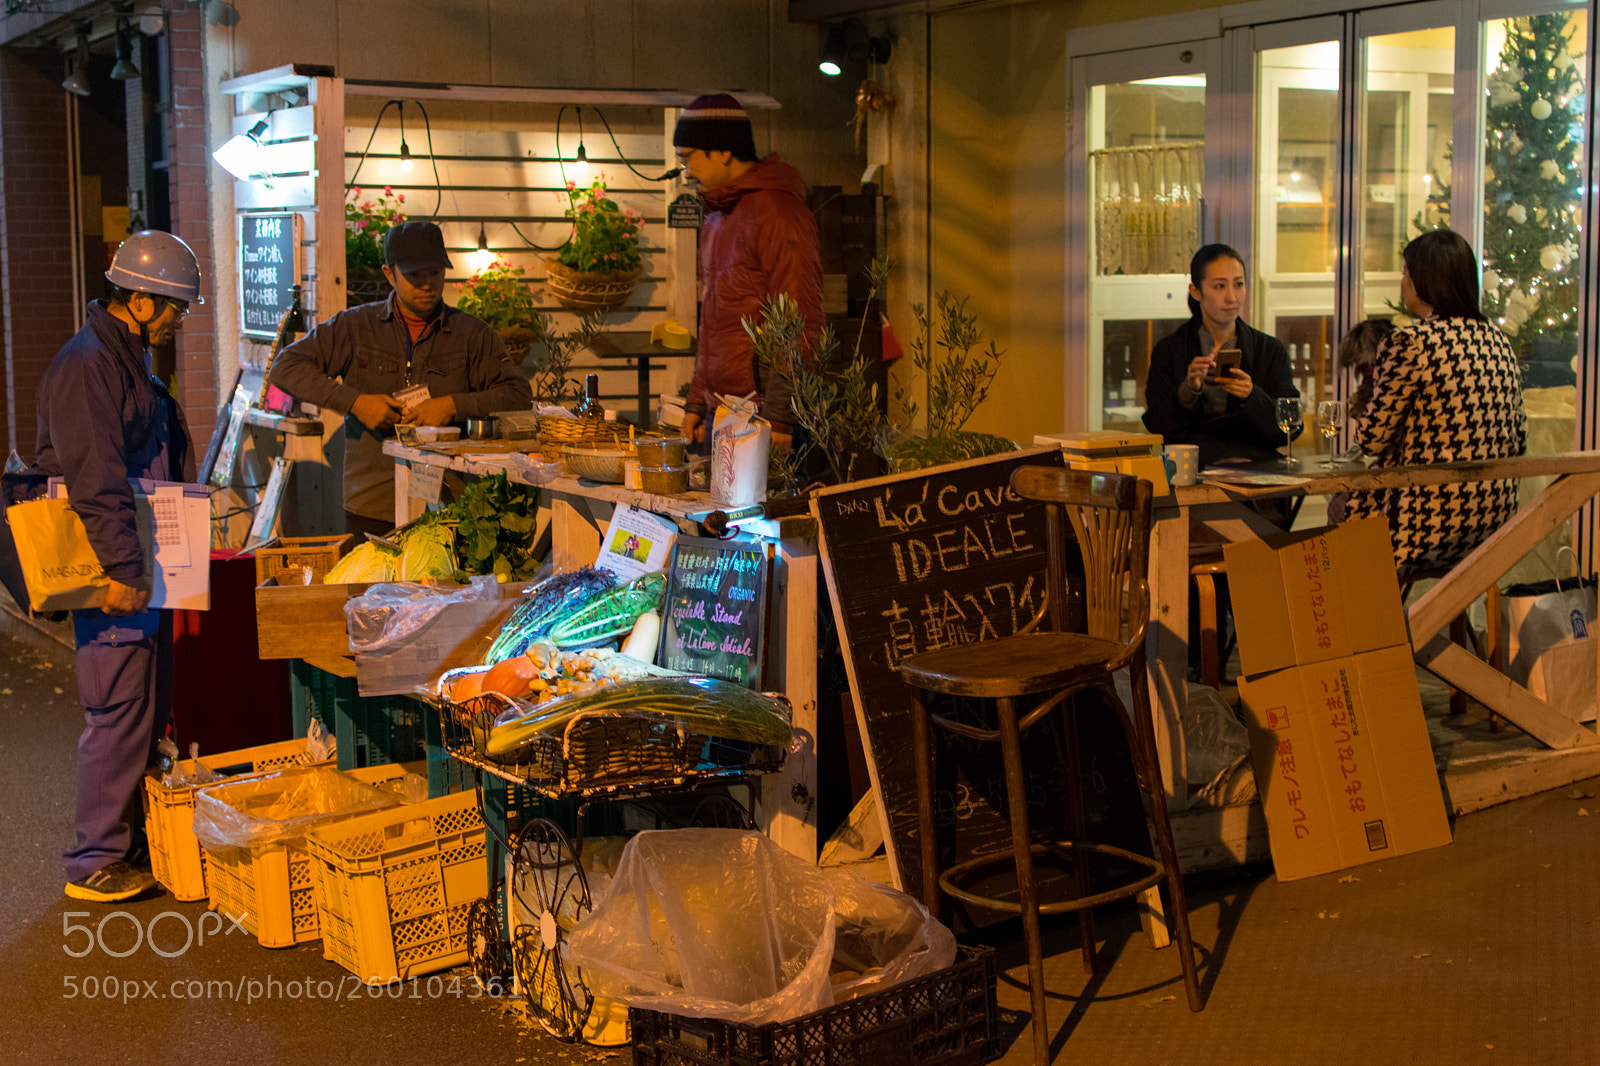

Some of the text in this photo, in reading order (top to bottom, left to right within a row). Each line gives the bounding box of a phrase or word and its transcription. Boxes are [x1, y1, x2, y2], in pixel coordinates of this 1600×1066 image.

[670, 596, 743, 628] Vegetable Stand
[728, 585, 756, 602] ORGANIC
[880, 575, 1047, 673] 直輸入ワイ
[1277, 738, 1310, 840] ワレモノ注意
[1320, 679, 1366, 813] おもてなしたまご
